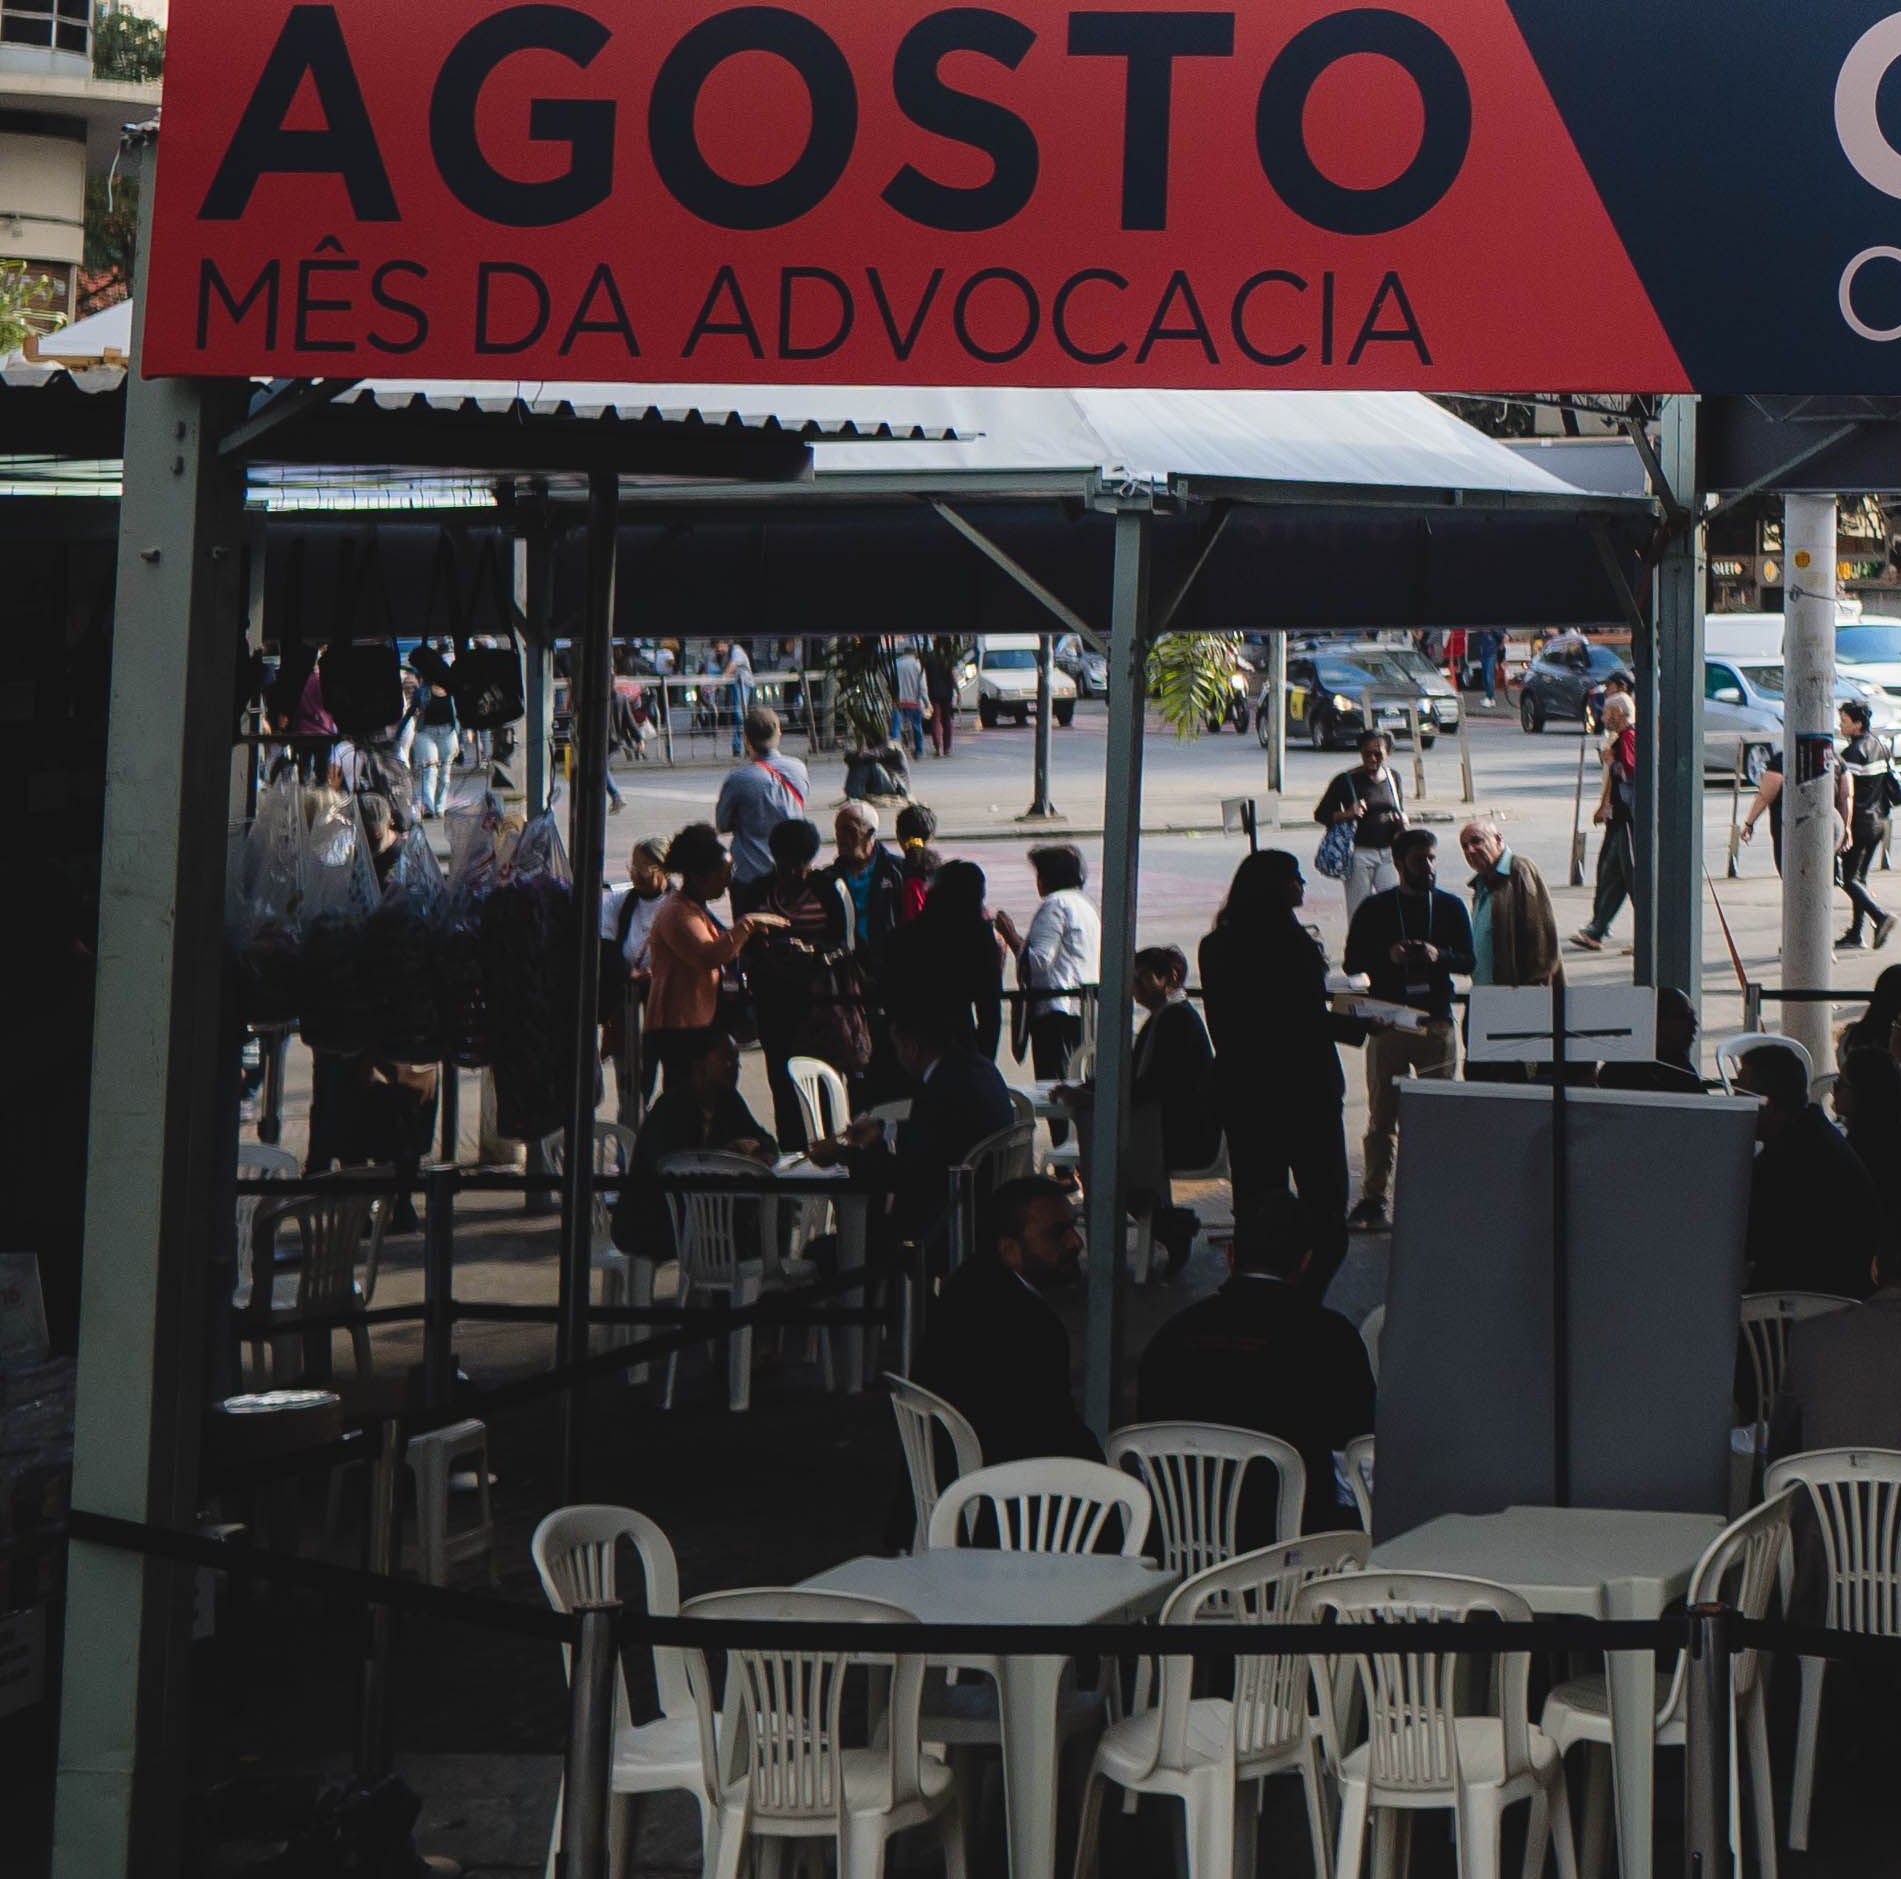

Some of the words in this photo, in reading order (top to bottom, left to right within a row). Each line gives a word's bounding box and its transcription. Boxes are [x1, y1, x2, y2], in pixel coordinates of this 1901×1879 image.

[197, 4, 1471, 235] AGOSTO
[196, 235, 428, 354] MÊS
[475, 262, 640, 357] DA
[681, 265, 1433, 366] ADVOCACIA
